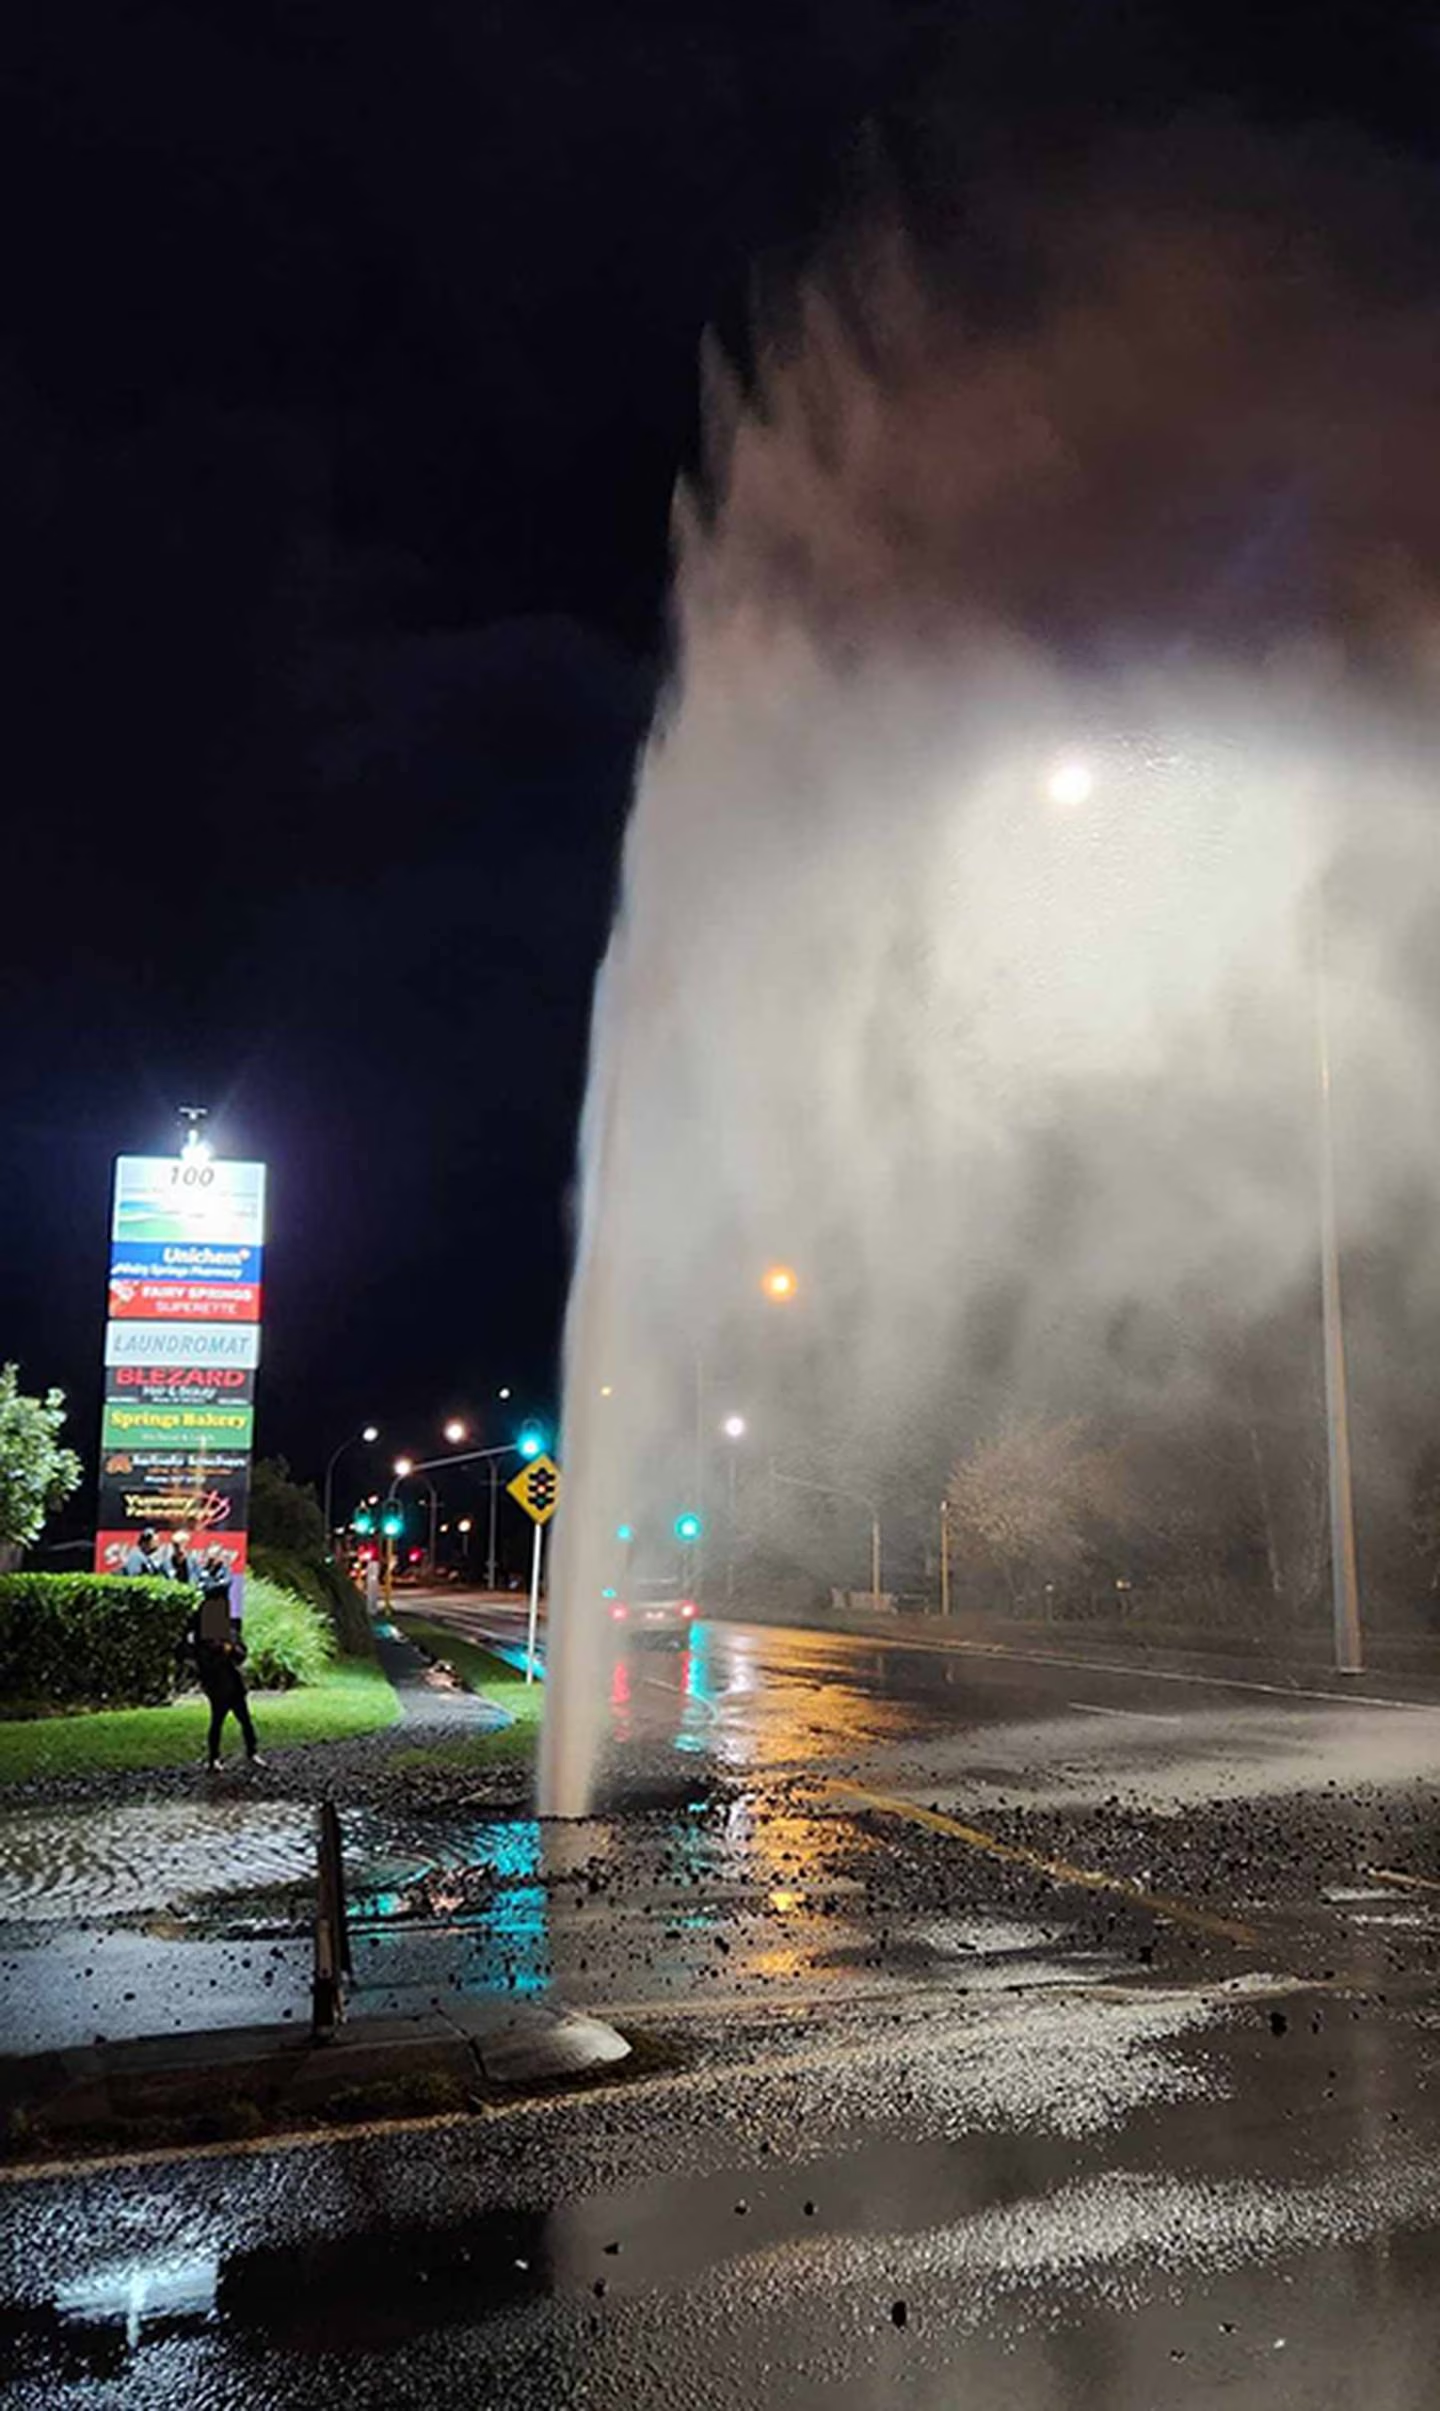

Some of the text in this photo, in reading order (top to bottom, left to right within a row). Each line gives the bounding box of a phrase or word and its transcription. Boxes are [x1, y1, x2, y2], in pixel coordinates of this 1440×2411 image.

[171, 1167, 215, 1186] 100
[142, 1286, 252, 1302] FAIRY SPRINGS
[155, 1301, 236, 1314] SUPERETTE
[113, 1335, 251, 1354] LAUNDROMAT
[116, 1367, 246, 1387] BLEZARD
[111, 1410, 246, 1430] Springs Bakery
